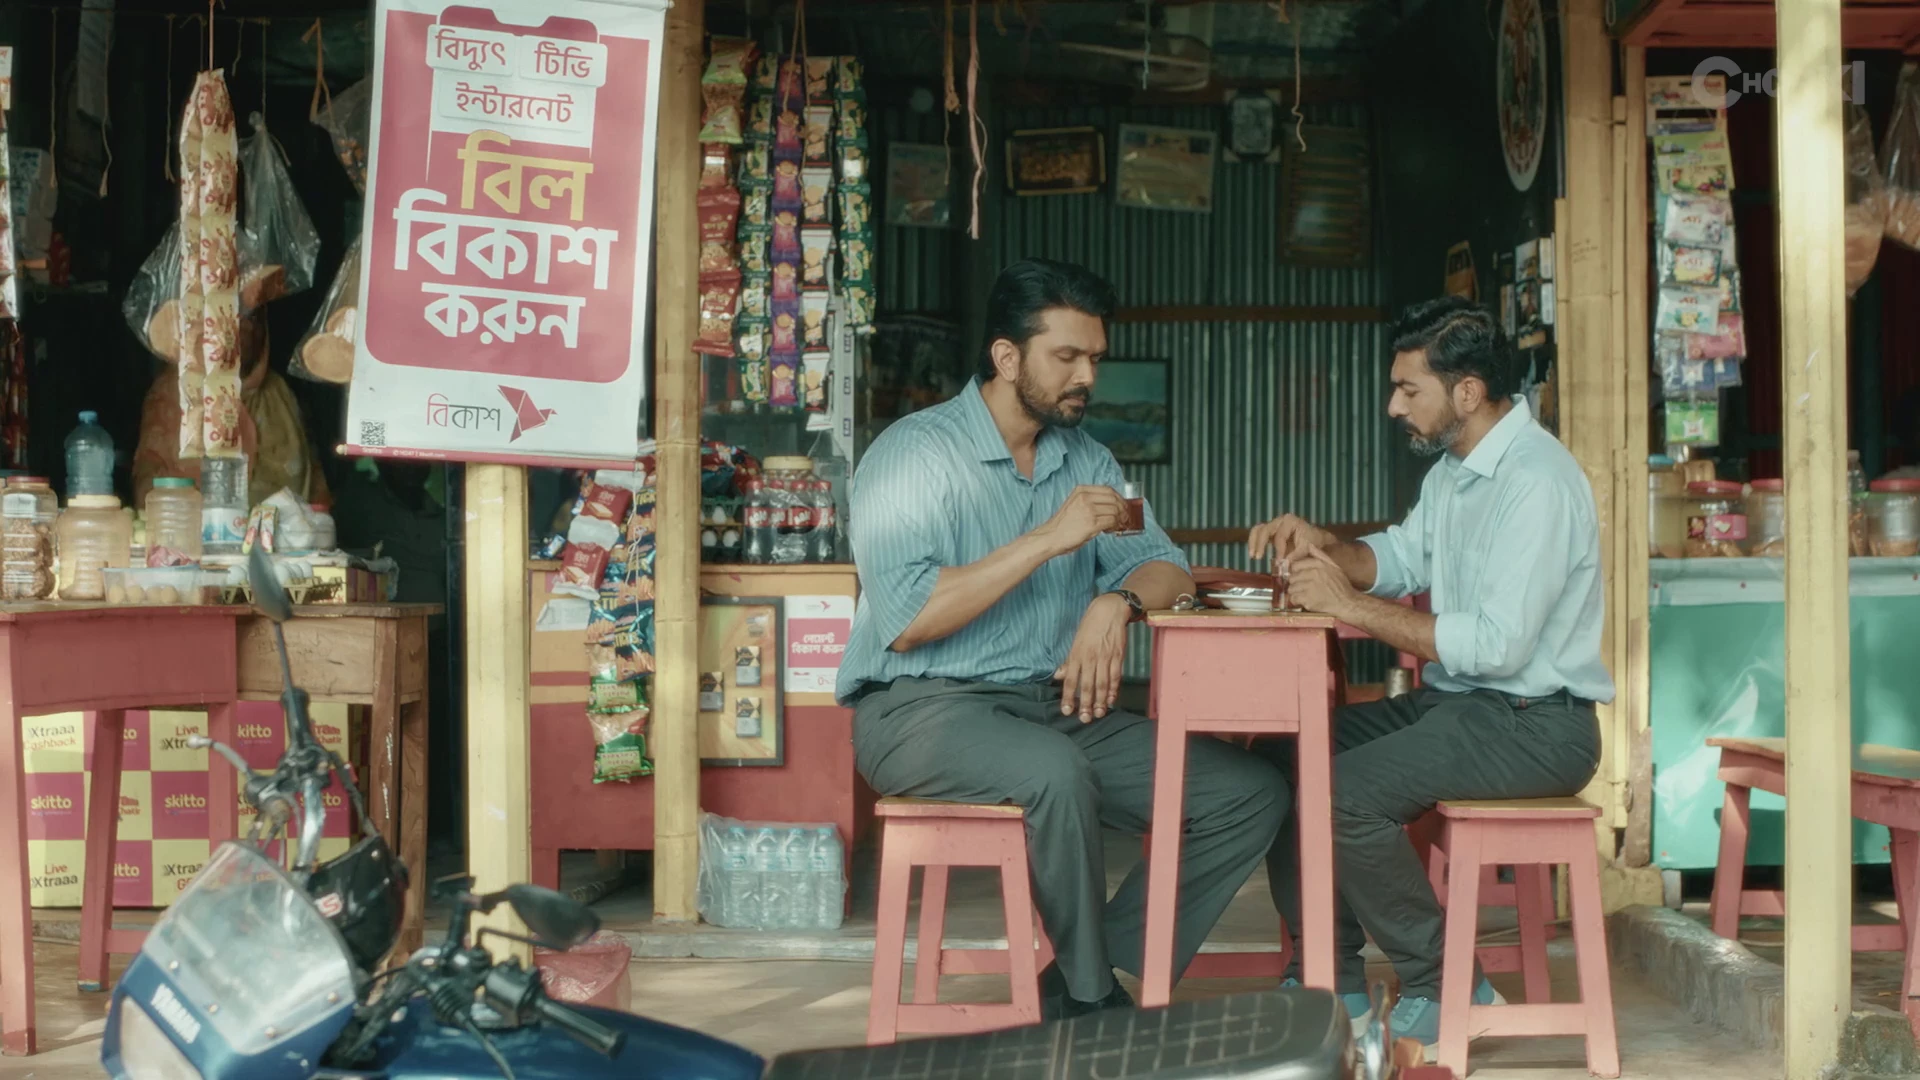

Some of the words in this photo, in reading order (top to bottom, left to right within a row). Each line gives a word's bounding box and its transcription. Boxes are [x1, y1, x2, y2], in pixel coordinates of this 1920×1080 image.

[435, 29, 506, 71] বিদ্যুৎ
[534, 41, 593, 78] টিভি
[455, 82, 574, 123] ইন্টারনেট
[457, 129, 594, 222] বিল
[392, 187, 619, 290] বিকাশ
[421, 281, 587, 349] করুন
[427, 393, 501, 431] বিকাশ
[175, 725, 199, 737] Live
[237, 724, 272, 739] kitto
[31, 795, 72, 809] skitto
[165, 794, 206, 809] skitto
[45, 864, 68, 874] Live
[114, 863, 140, 877] itto
